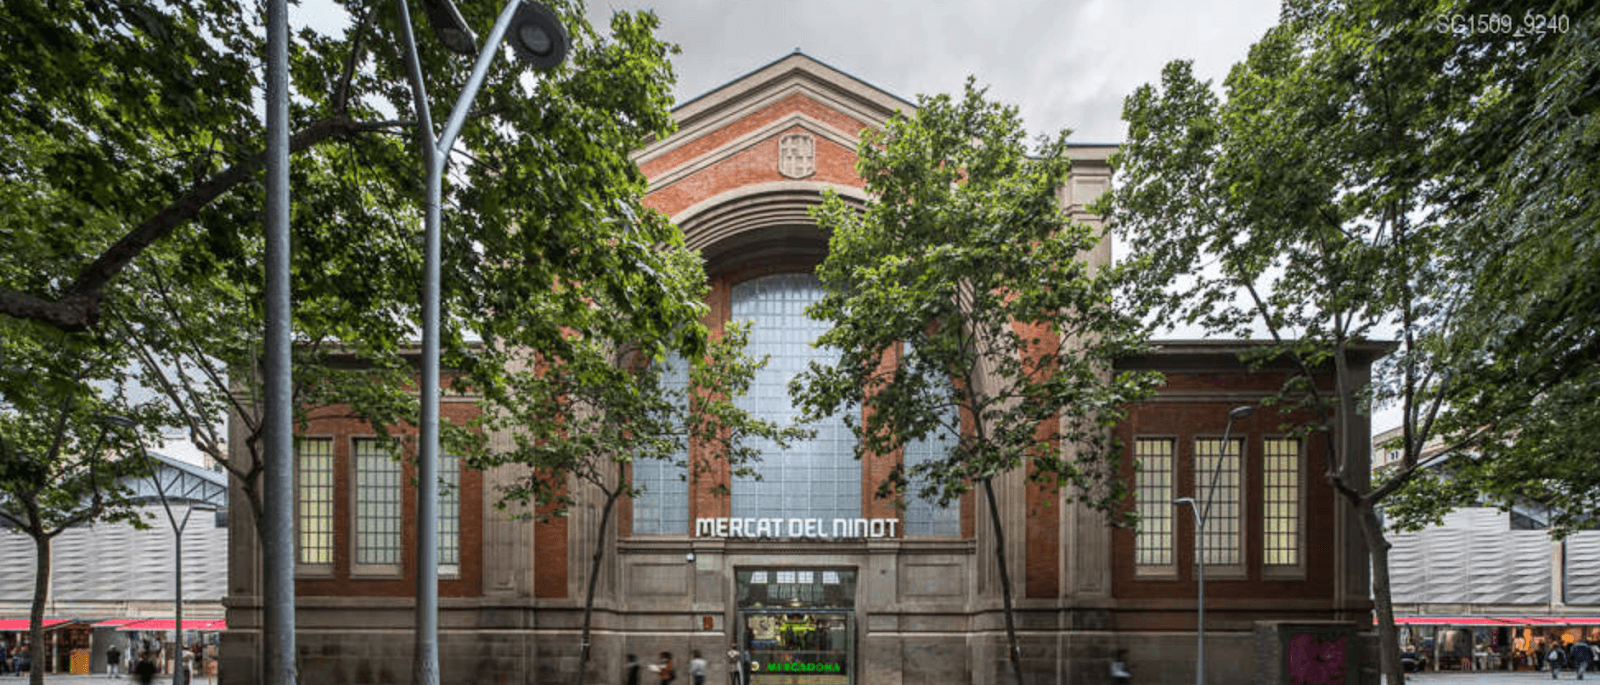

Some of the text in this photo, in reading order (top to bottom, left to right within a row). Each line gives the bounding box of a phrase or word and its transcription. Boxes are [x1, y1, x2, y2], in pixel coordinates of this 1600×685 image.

[696, 518, 899, 537] MERCAT DEL NINOT
